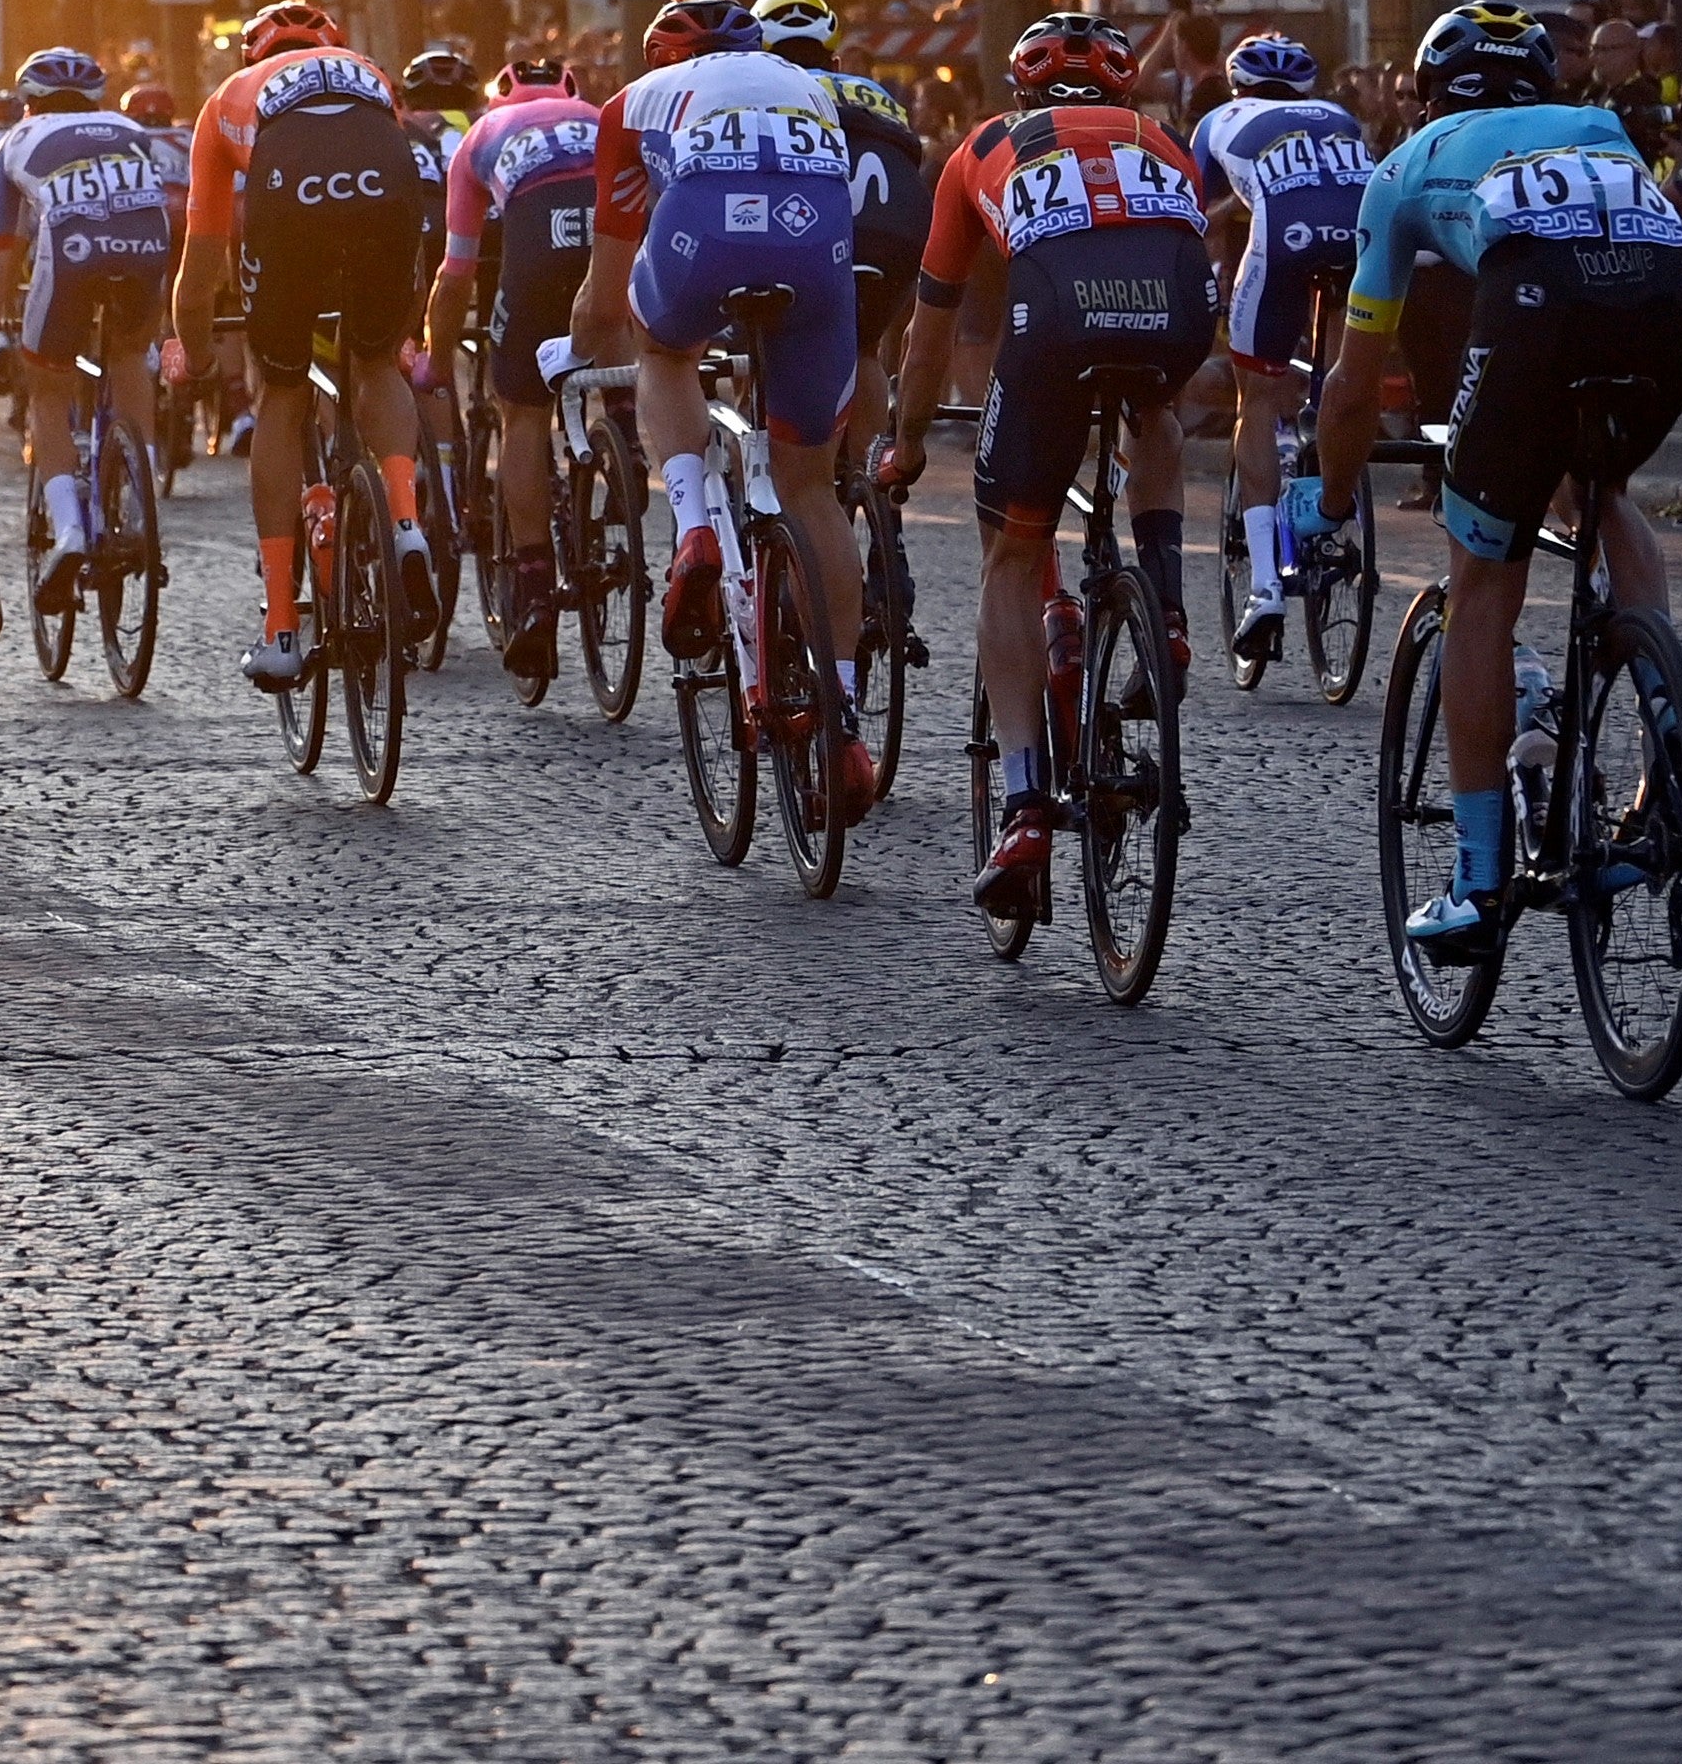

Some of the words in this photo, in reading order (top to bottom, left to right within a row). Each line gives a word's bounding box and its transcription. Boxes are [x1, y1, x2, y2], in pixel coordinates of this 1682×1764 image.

[688, 113, 746, 153] 54
[786, 116, 845, 159] 54
[1262, 138, 1313, 182] 174
[48, 168, 100, 207] 175
[297, 169, 385, 205] CCC
[1012, 163, 1070, 220] 42
[1494, 156, 1570, 210] 75
[94, 235, 166, 255] TOTAL
[1073, 278, 1168, 311] BAHRAIN
[1084, 312, 1169, 331] MERIDA
[979, 377, 1004, 468] MERIDA
